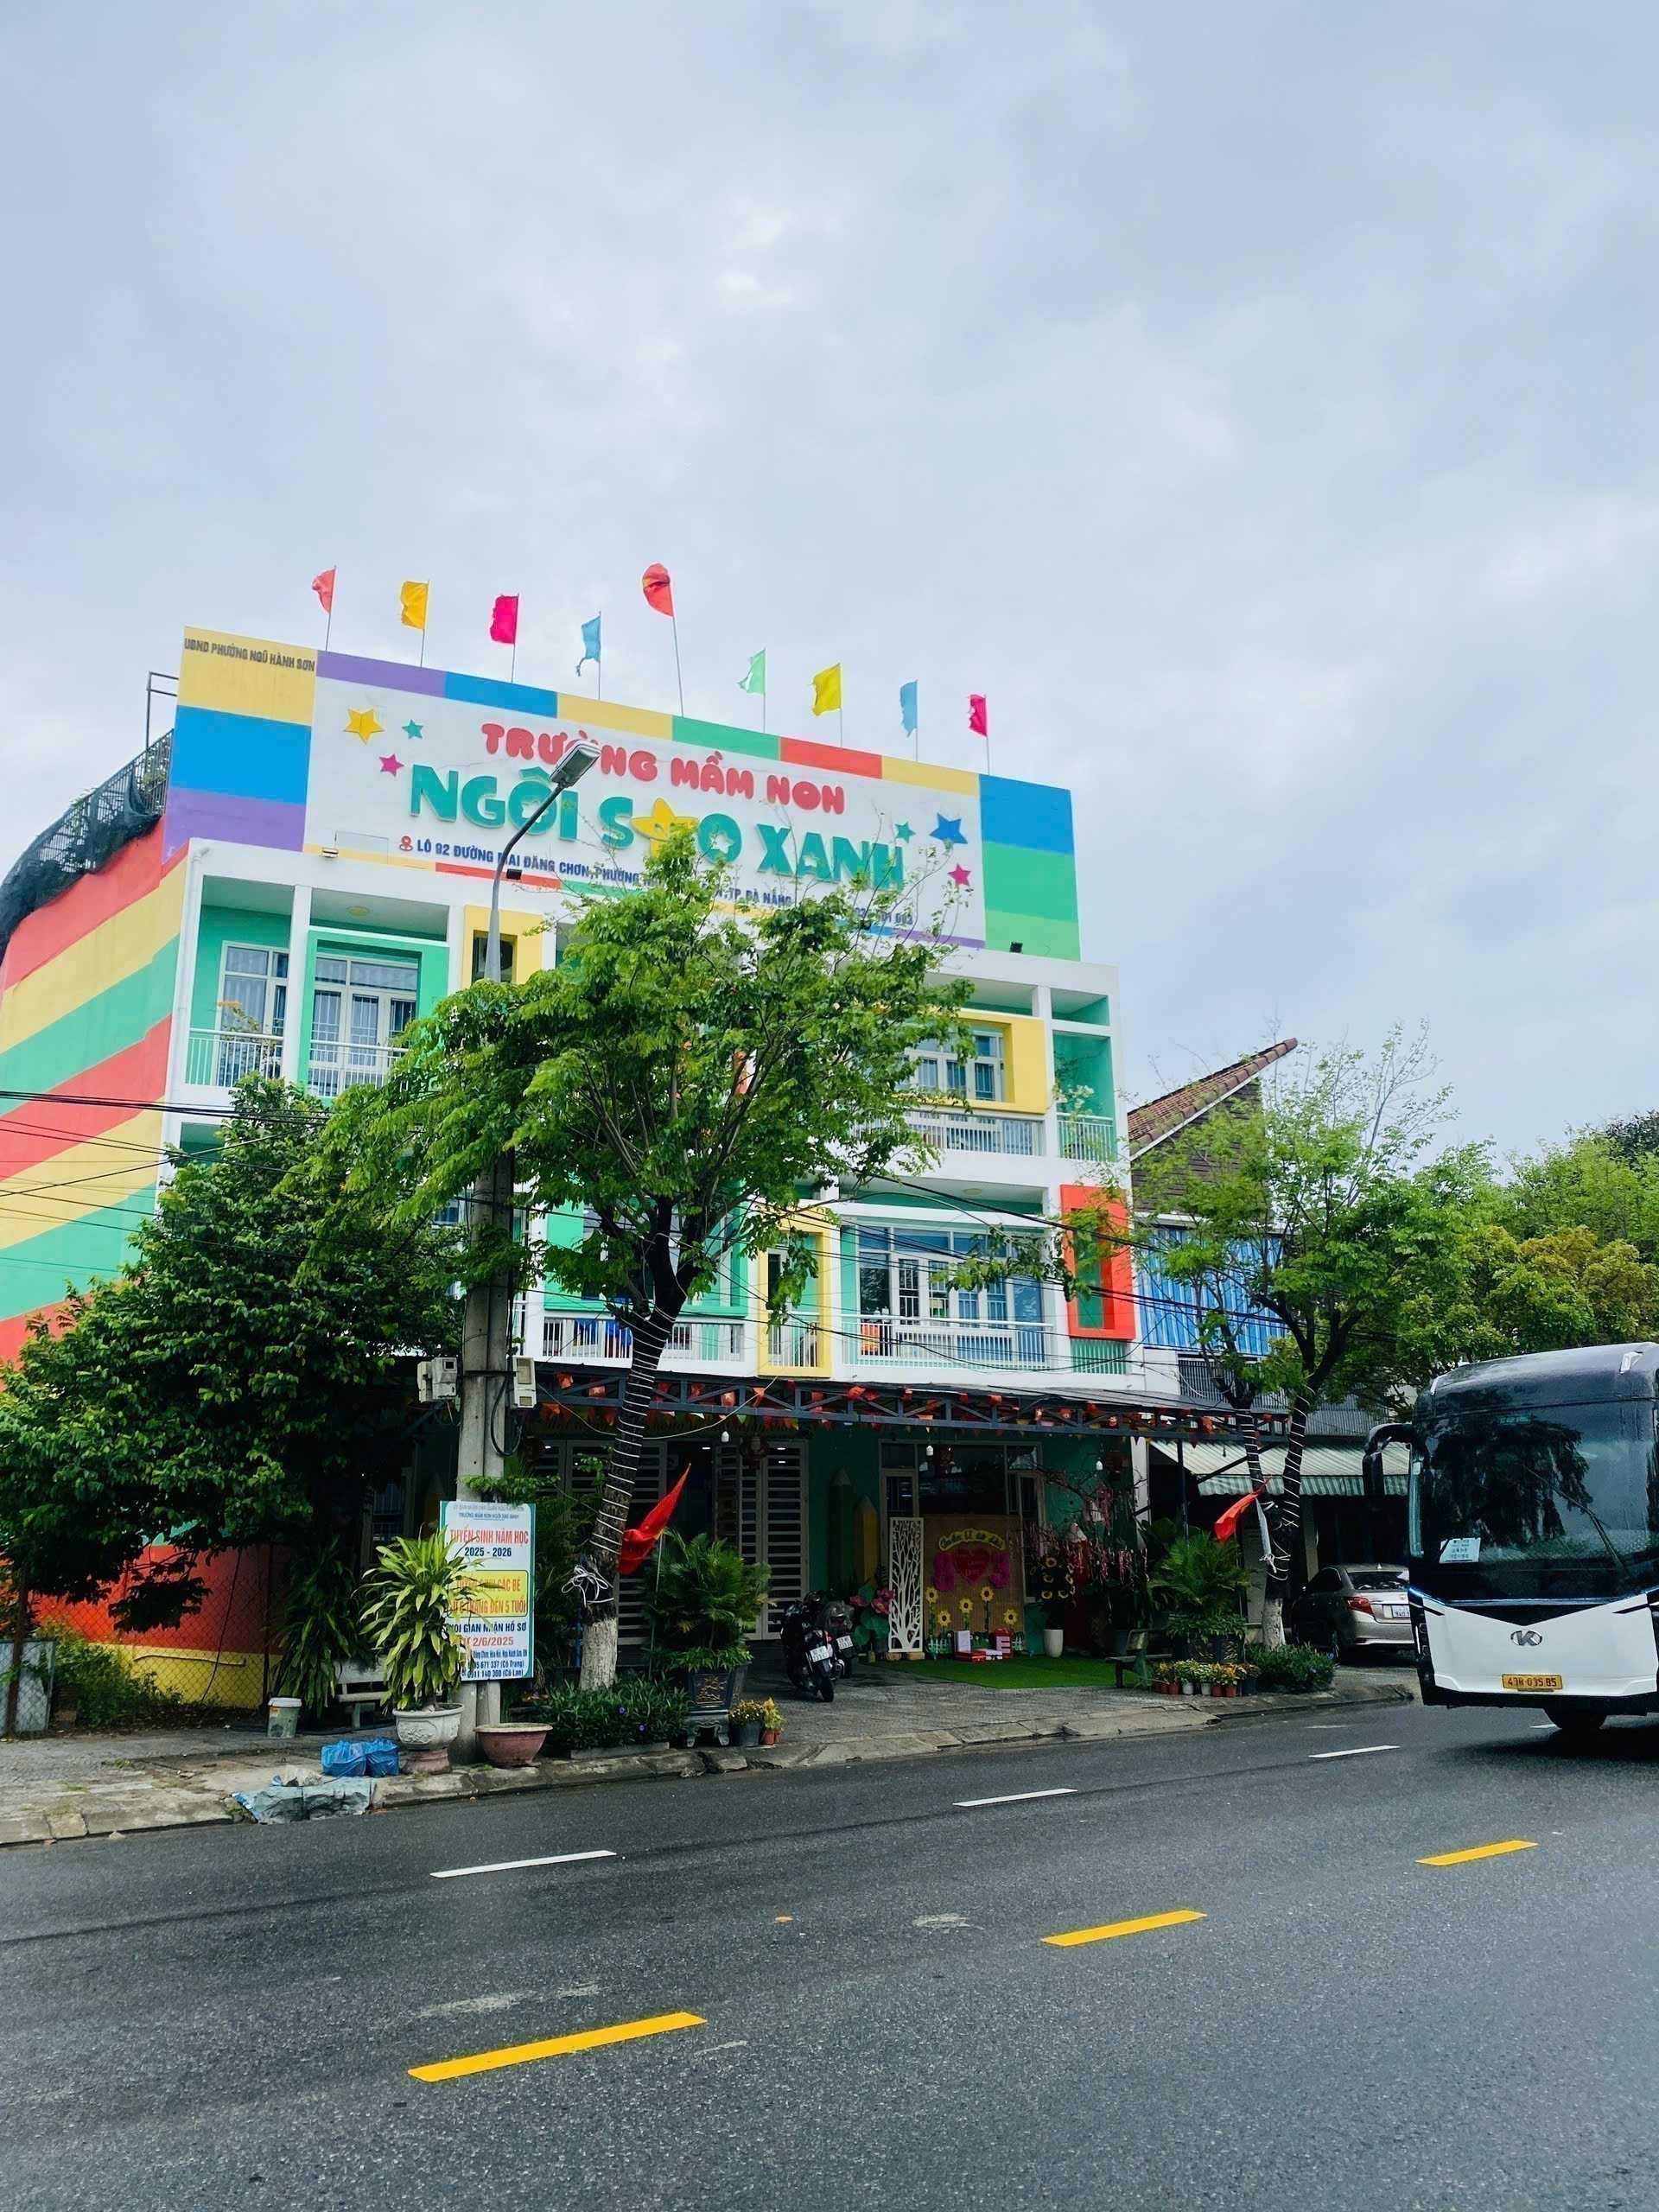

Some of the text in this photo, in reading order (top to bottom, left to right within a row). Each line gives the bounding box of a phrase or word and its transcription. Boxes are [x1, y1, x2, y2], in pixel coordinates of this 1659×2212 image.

[184, 638, 315, 671] UBND PHƯỜNG NGŨ HÀNH SƠN
[671, 750, 754, 799] MẦM
[766, 774, 845, 815] NON
[410, 765, 578, 842] NGÔI
[756, 823, 904, 891] XANH
[417, 839, 431, 852] LÔ
[435, 843, 449, 855] 92
[454, 845, 493, 862] ĐƯỜNG
[524, 855, 555, 871] ĐĂNG
[476, 1529, 493, 1543] SINH
[496, 1528, 512, 1544] NĂM
[514, 1530, 529, 1547] HỌC
[465, 1547, 484, 1556] 2025
[493, 1548, 512, 1556] 2026
[512, 1576, 521, 1592] BÉ
[505, 1601, 510, 1613] 5
[463, 1624, 481, 1632] GIAN
[517, 1622, 526, 1631] SƠ
[473, 1637, 514, 1647] 2/6/2025
